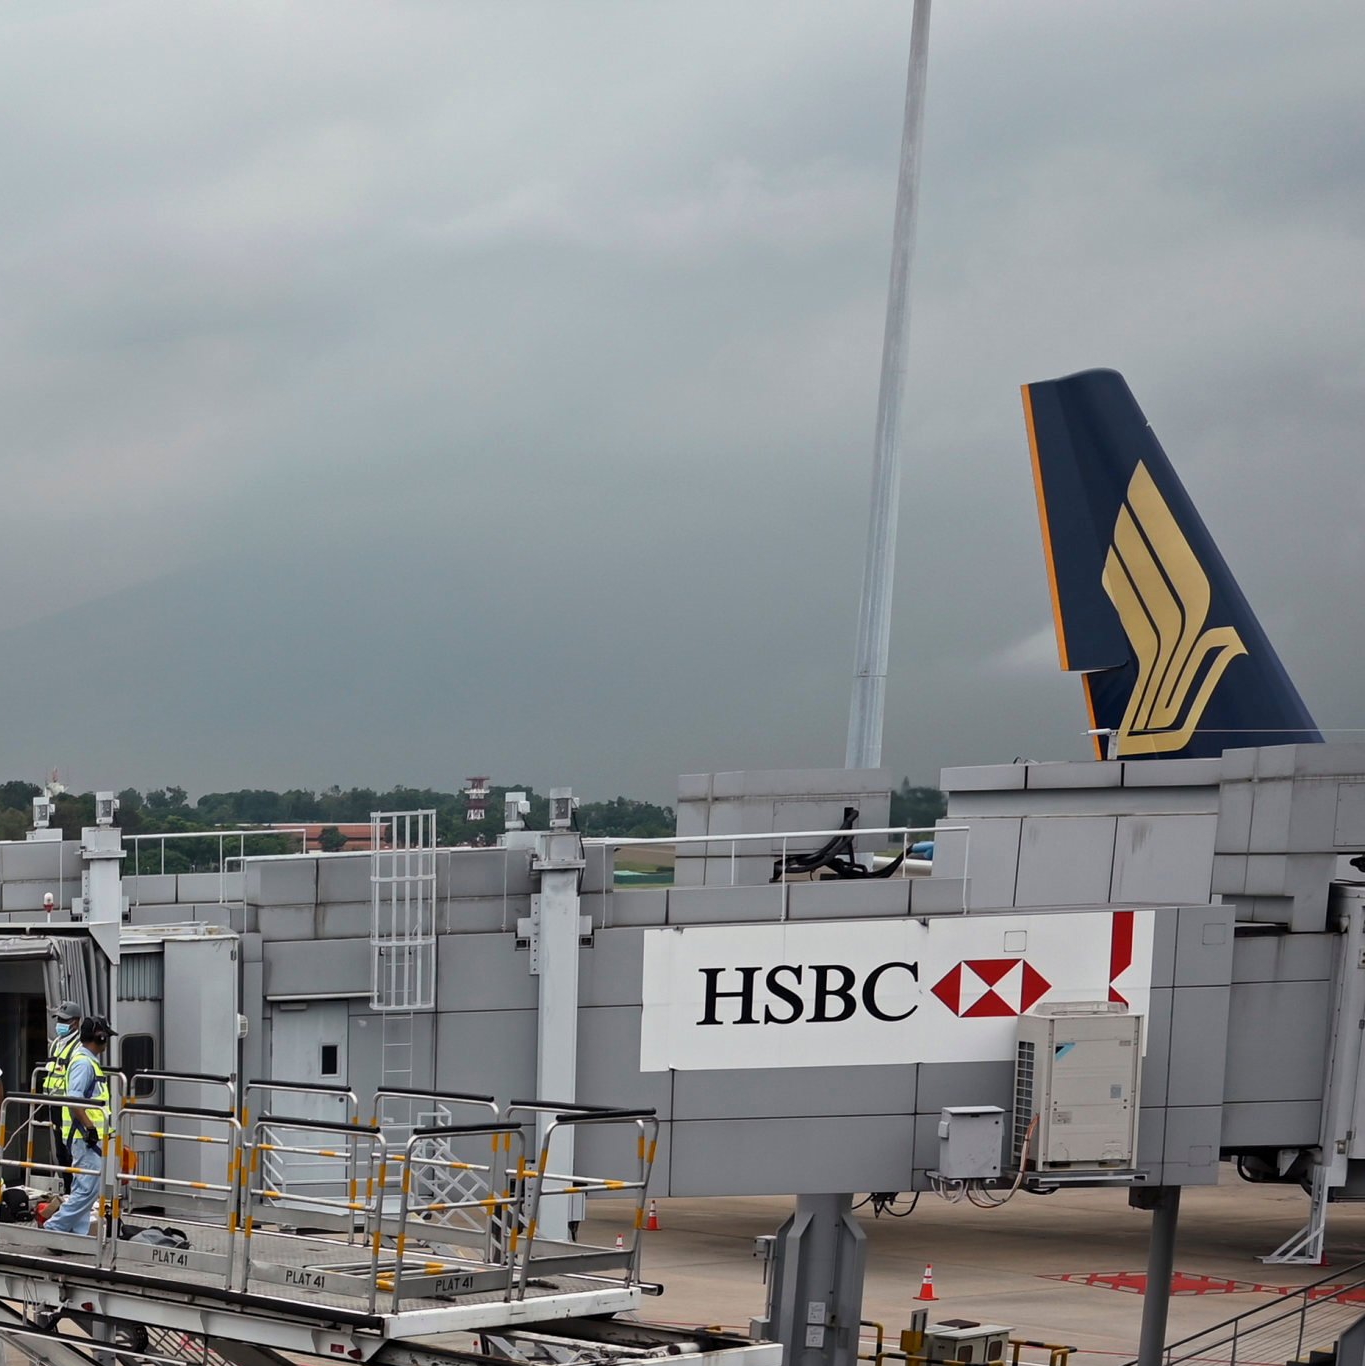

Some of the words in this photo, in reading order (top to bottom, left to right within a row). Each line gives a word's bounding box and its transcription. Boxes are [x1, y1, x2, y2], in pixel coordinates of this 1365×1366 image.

[695, 960, 920, 1027] HSBC
[152, 1248, 175, 1265] PLAT
[176, 1252, 188, 1267] 41
[285, 1270, 311, 1287] PLAT
[313, 1273, 325, 1289] 41
[435, 1278, 460, 1293] PLAT
[461, 1275, 474, 1290] 41
